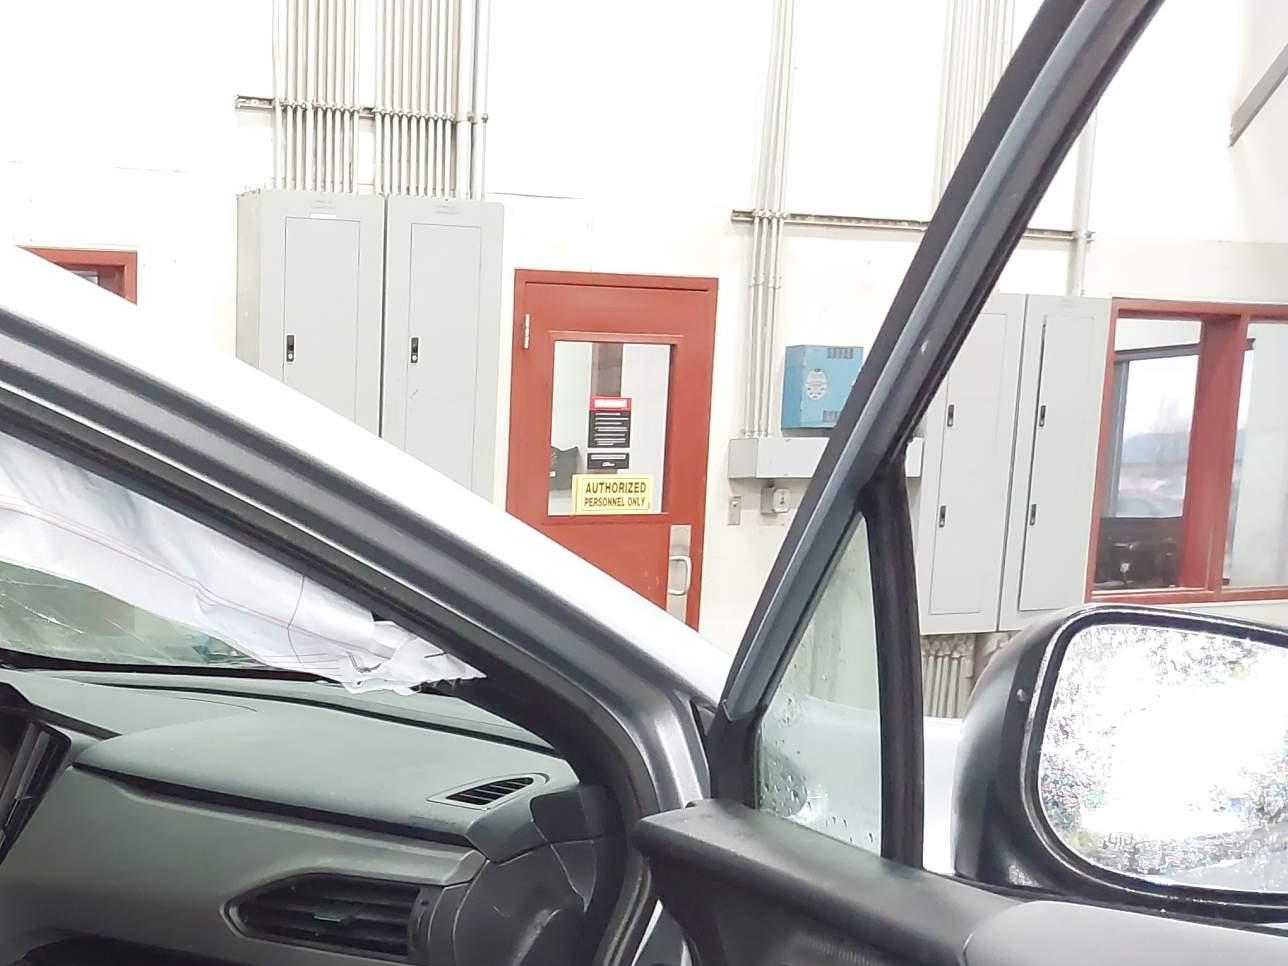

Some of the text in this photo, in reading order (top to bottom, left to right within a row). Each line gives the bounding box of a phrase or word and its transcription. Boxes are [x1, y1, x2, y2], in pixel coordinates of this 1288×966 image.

[585, 482, 647, 494] AUTHORIZED
[584, 497, 646, 507] PERSONNEL ONLY
